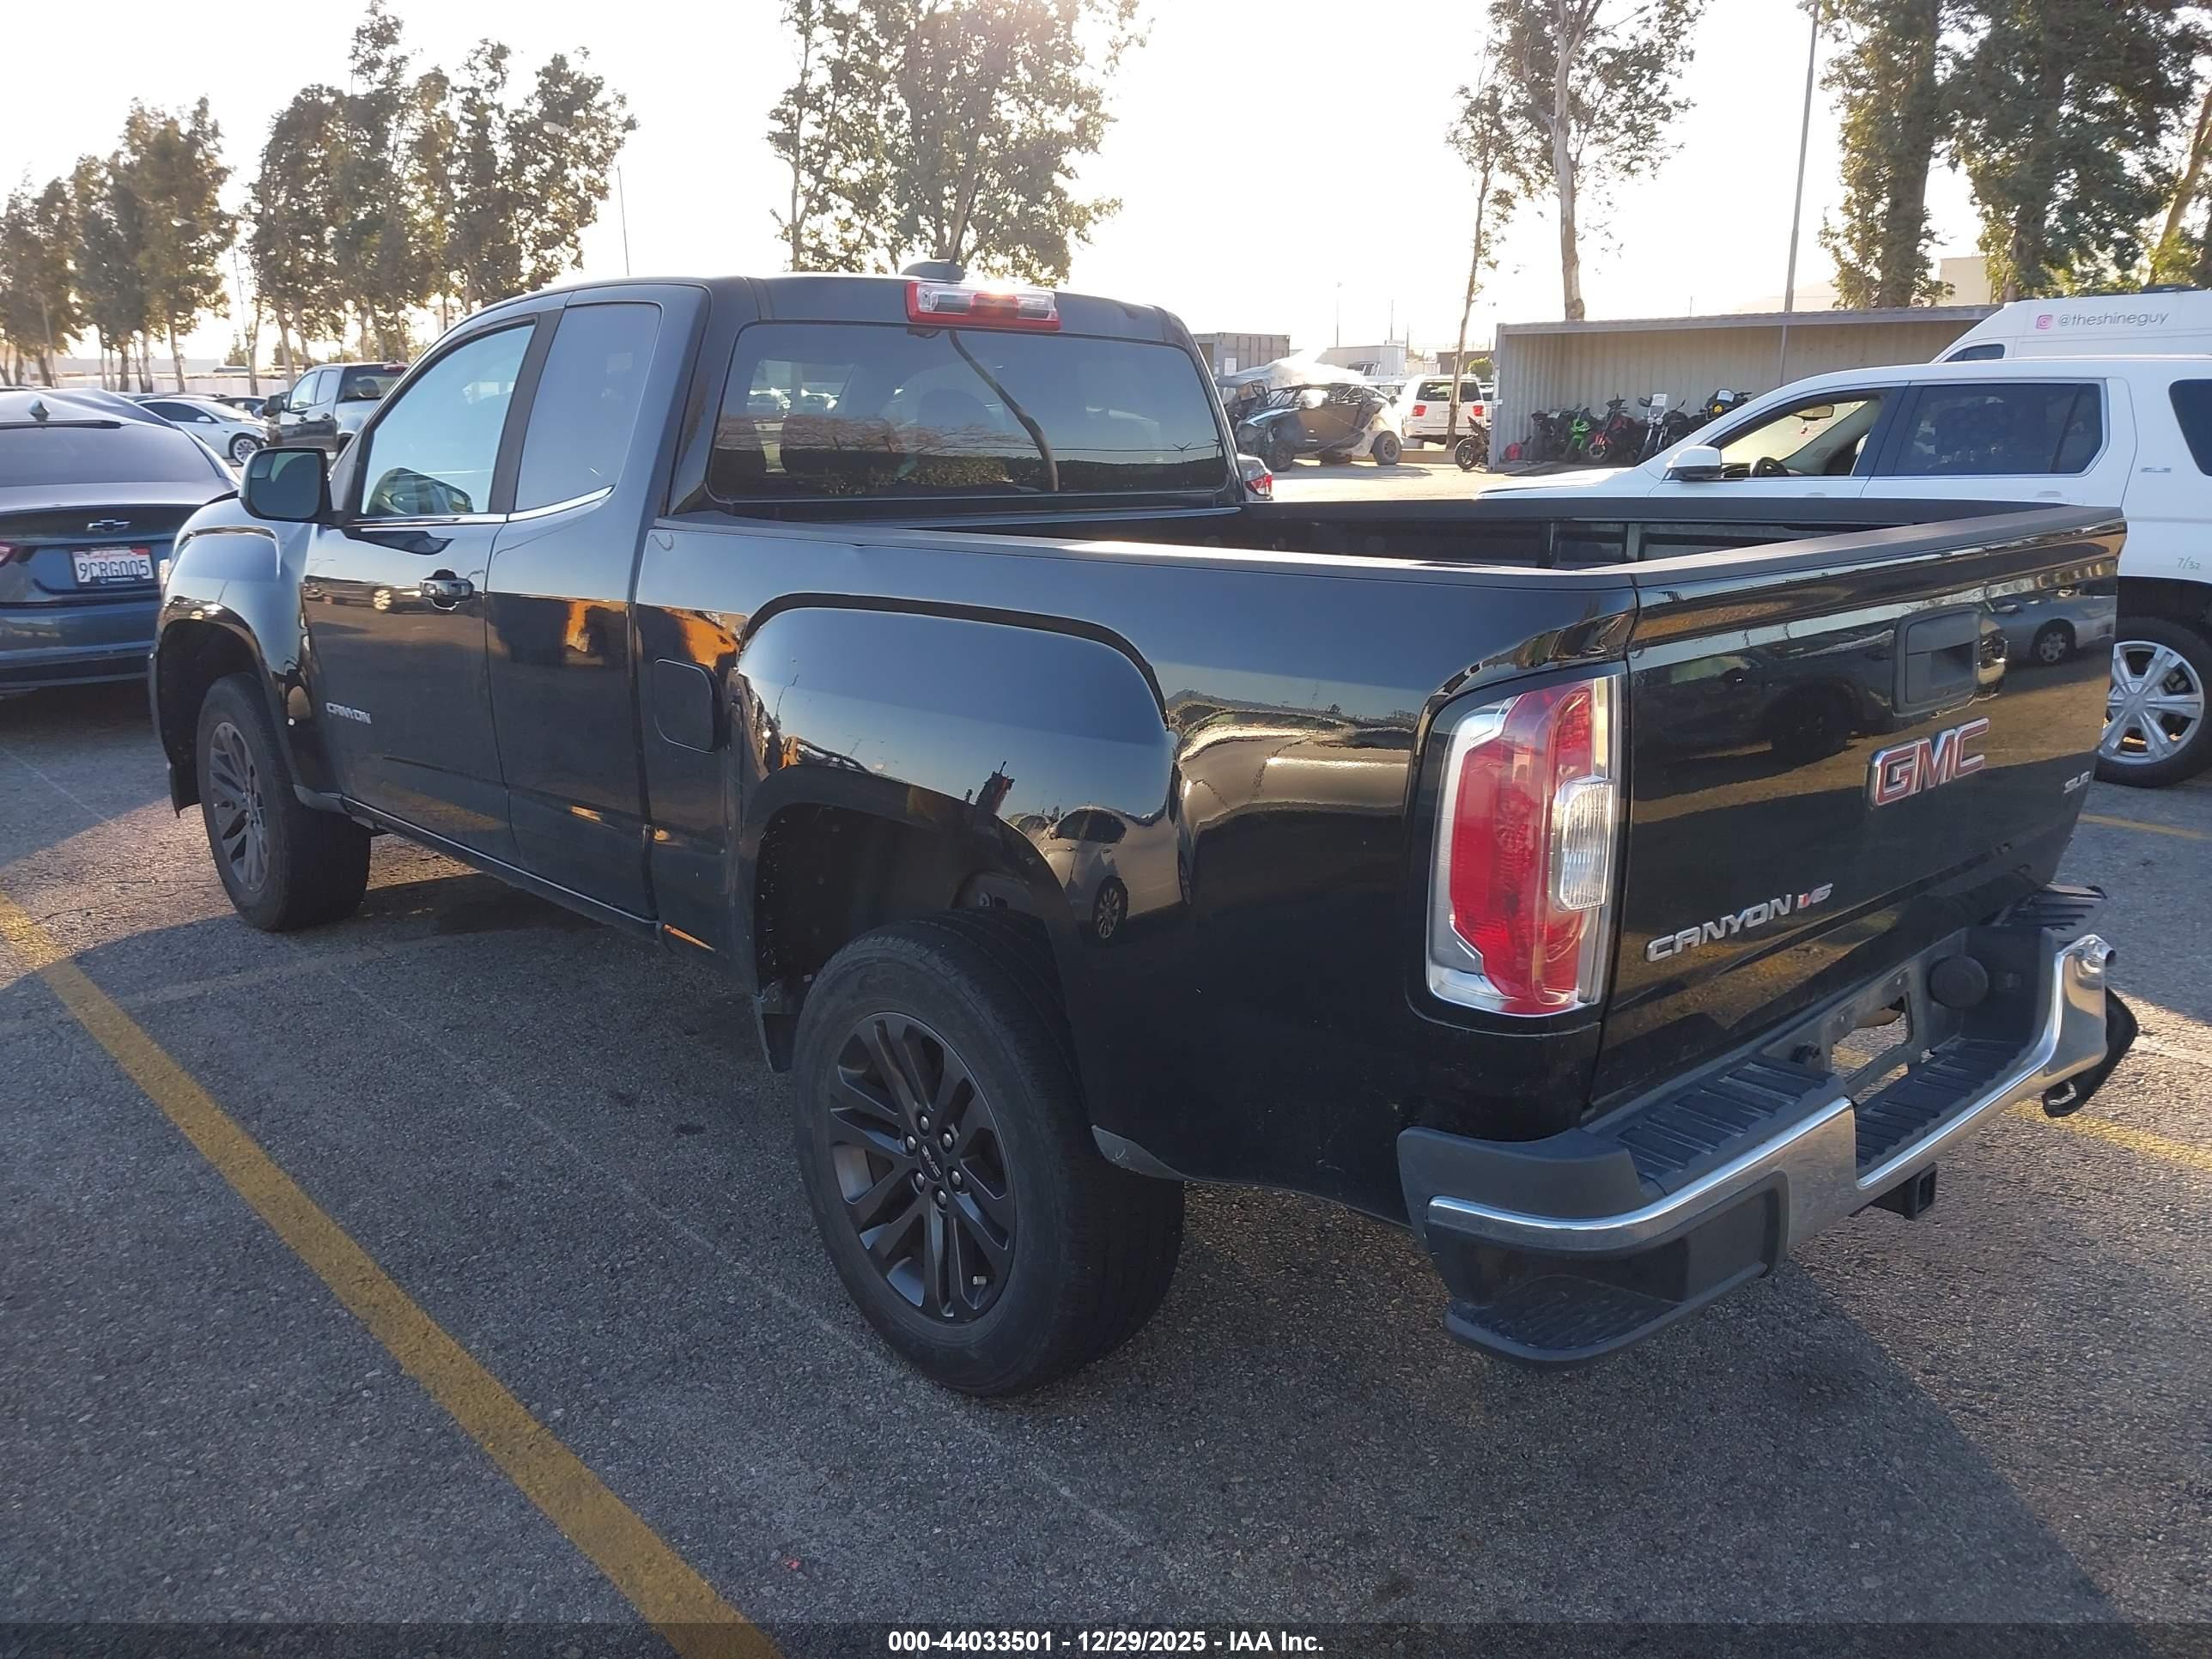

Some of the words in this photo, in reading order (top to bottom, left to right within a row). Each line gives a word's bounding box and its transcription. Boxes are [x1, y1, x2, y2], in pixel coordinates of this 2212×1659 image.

[2059, 312, 2169, 327] @theshineguy
[78, 560, 149, 580] 9CRG005
[2177, 556, 2201, 571] 7/32
[325, 702, 372, 725] CANYON
[1869, 716, 1990, 806] GMC
[1646, 894, 1793, 963] CANYON
